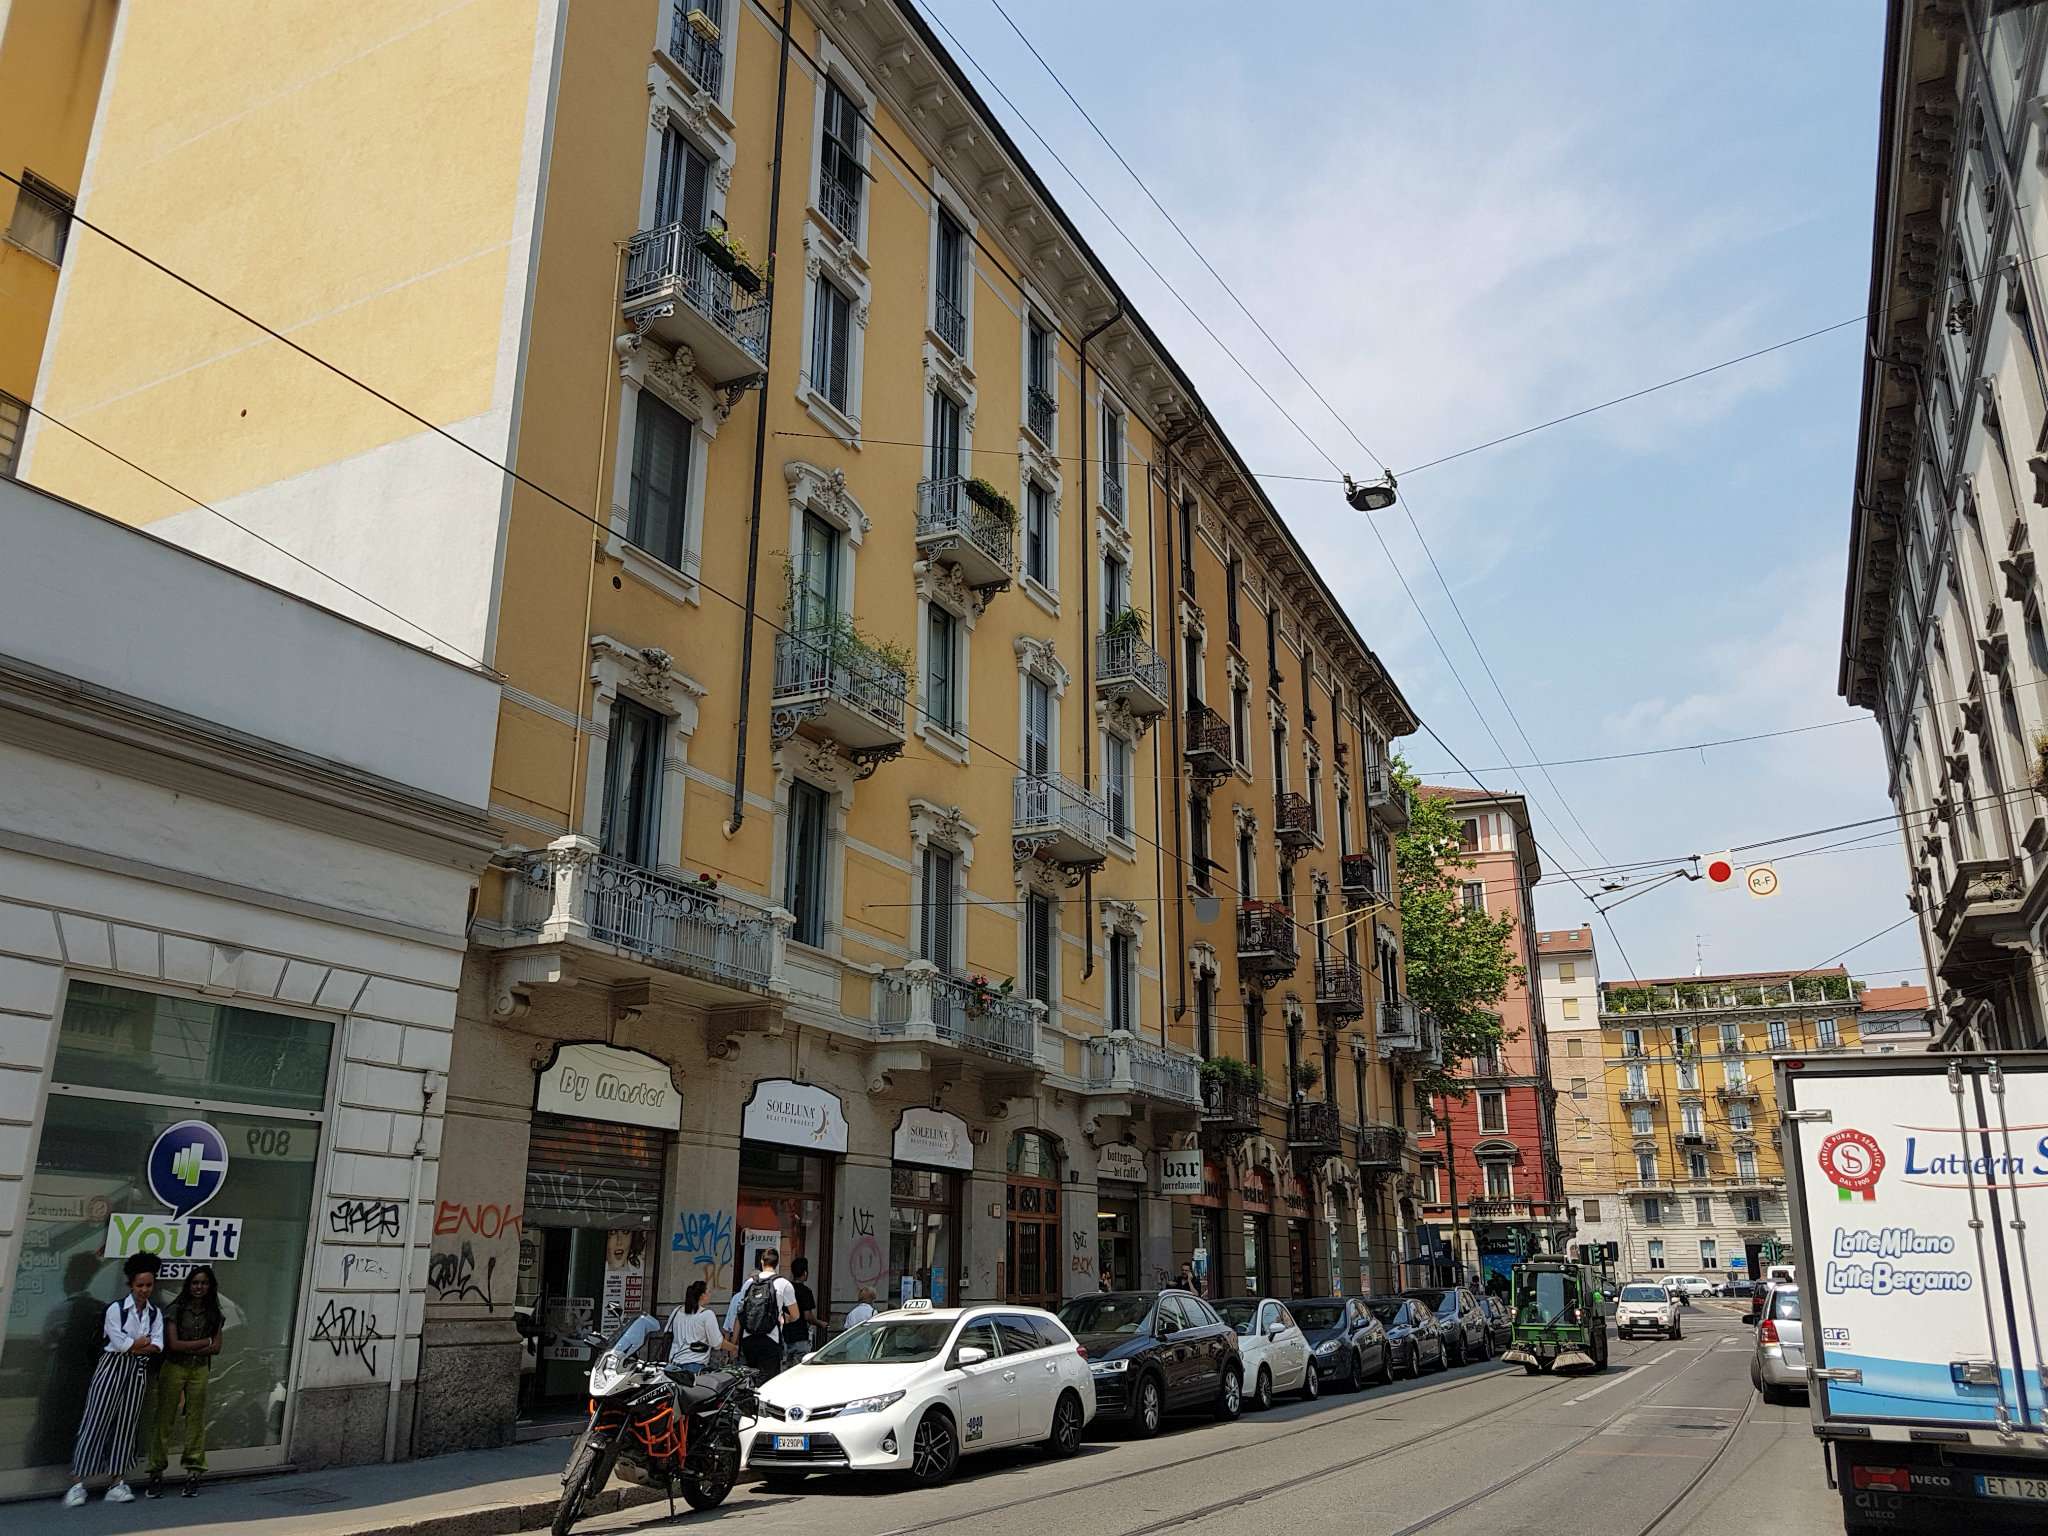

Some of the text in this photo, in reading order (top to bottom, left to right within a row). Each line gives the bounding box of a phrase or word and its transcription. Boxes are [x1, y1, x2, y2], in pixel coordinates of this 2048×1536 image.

[560, 1066, 665, 1108] By Master
[1106, 1148, 1132, 1166] bottega
[1904, 1137, 2025, 1175] Latteria
[1163, 1157, 1200, 1178] bar
[903, 1300, 928, 1309] TAXI
[1823, 1328, 1849, 1340] ara
[1910, 1474, 1950, 1487] IVECO
[2016, 1480, 2048, 1498] 128
